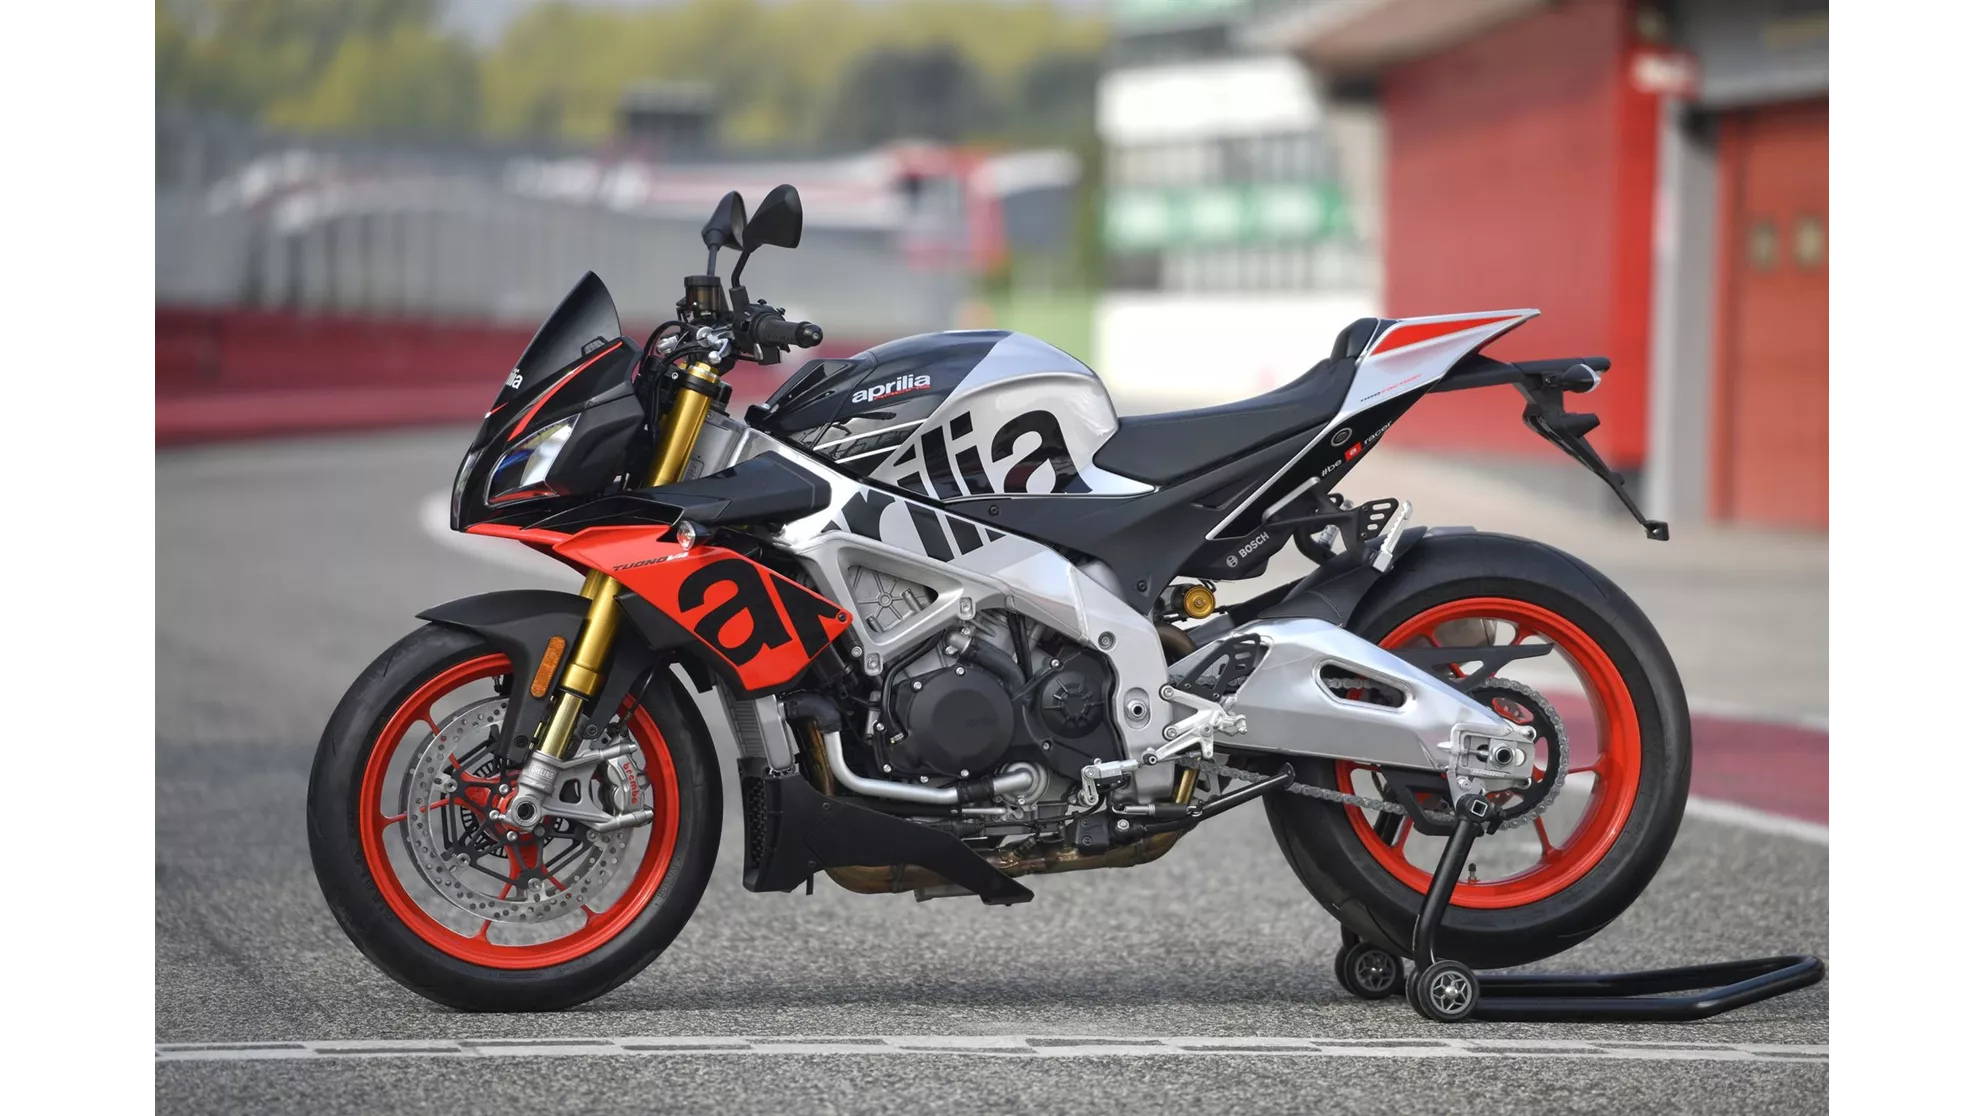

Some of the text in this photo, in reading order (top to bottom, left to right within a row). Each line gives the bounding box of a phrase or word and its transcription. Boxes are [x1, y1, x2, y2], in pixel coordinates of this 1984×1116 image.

[851, 373, 932, 403] aprilia
[1364, 420, 1393, 445] racer
[1238, 531, 1270, 559] BOSCH
[622, 761, 639, 804] brembo
